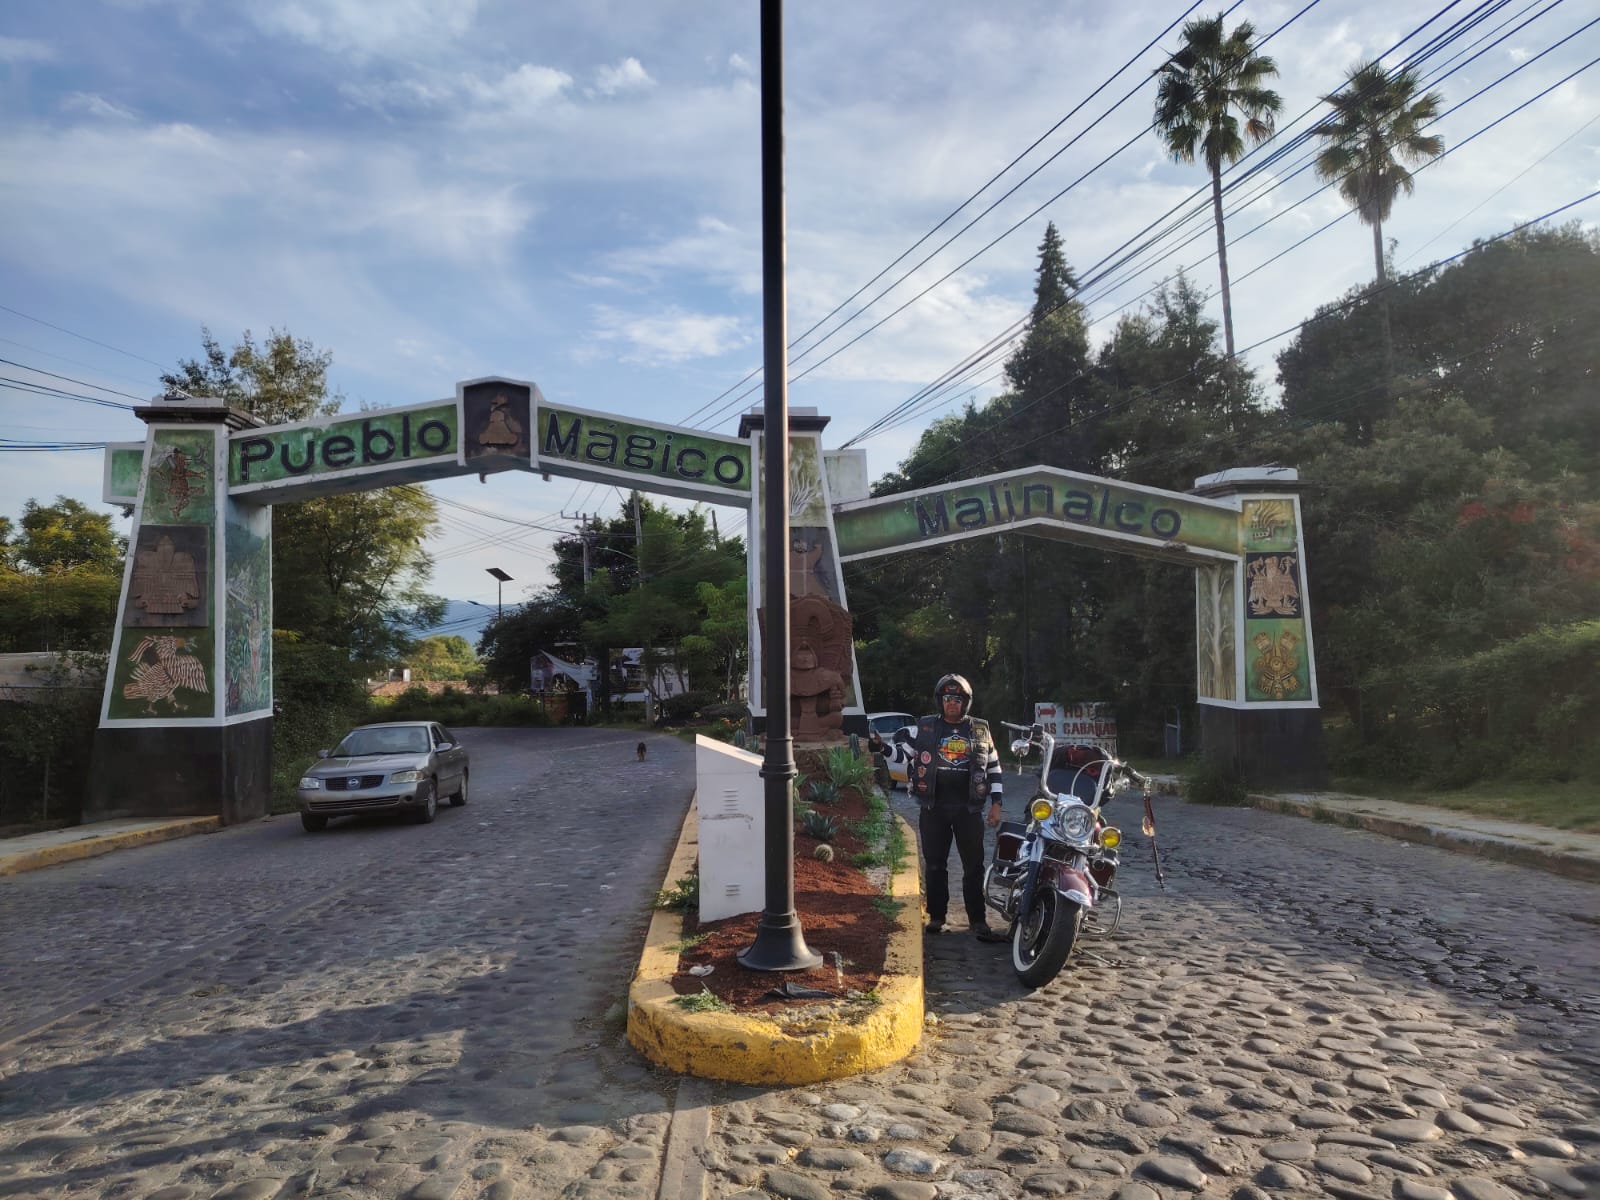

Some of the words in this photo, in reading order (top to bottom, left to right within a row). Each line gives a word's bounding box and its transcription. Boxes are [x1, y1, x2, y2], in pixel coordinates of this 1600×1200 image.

[240, 414, 452, 481] Pueblo
[544, 411, 744, 484] Mágico
[914, 481, 1182, 538] Malinalco
